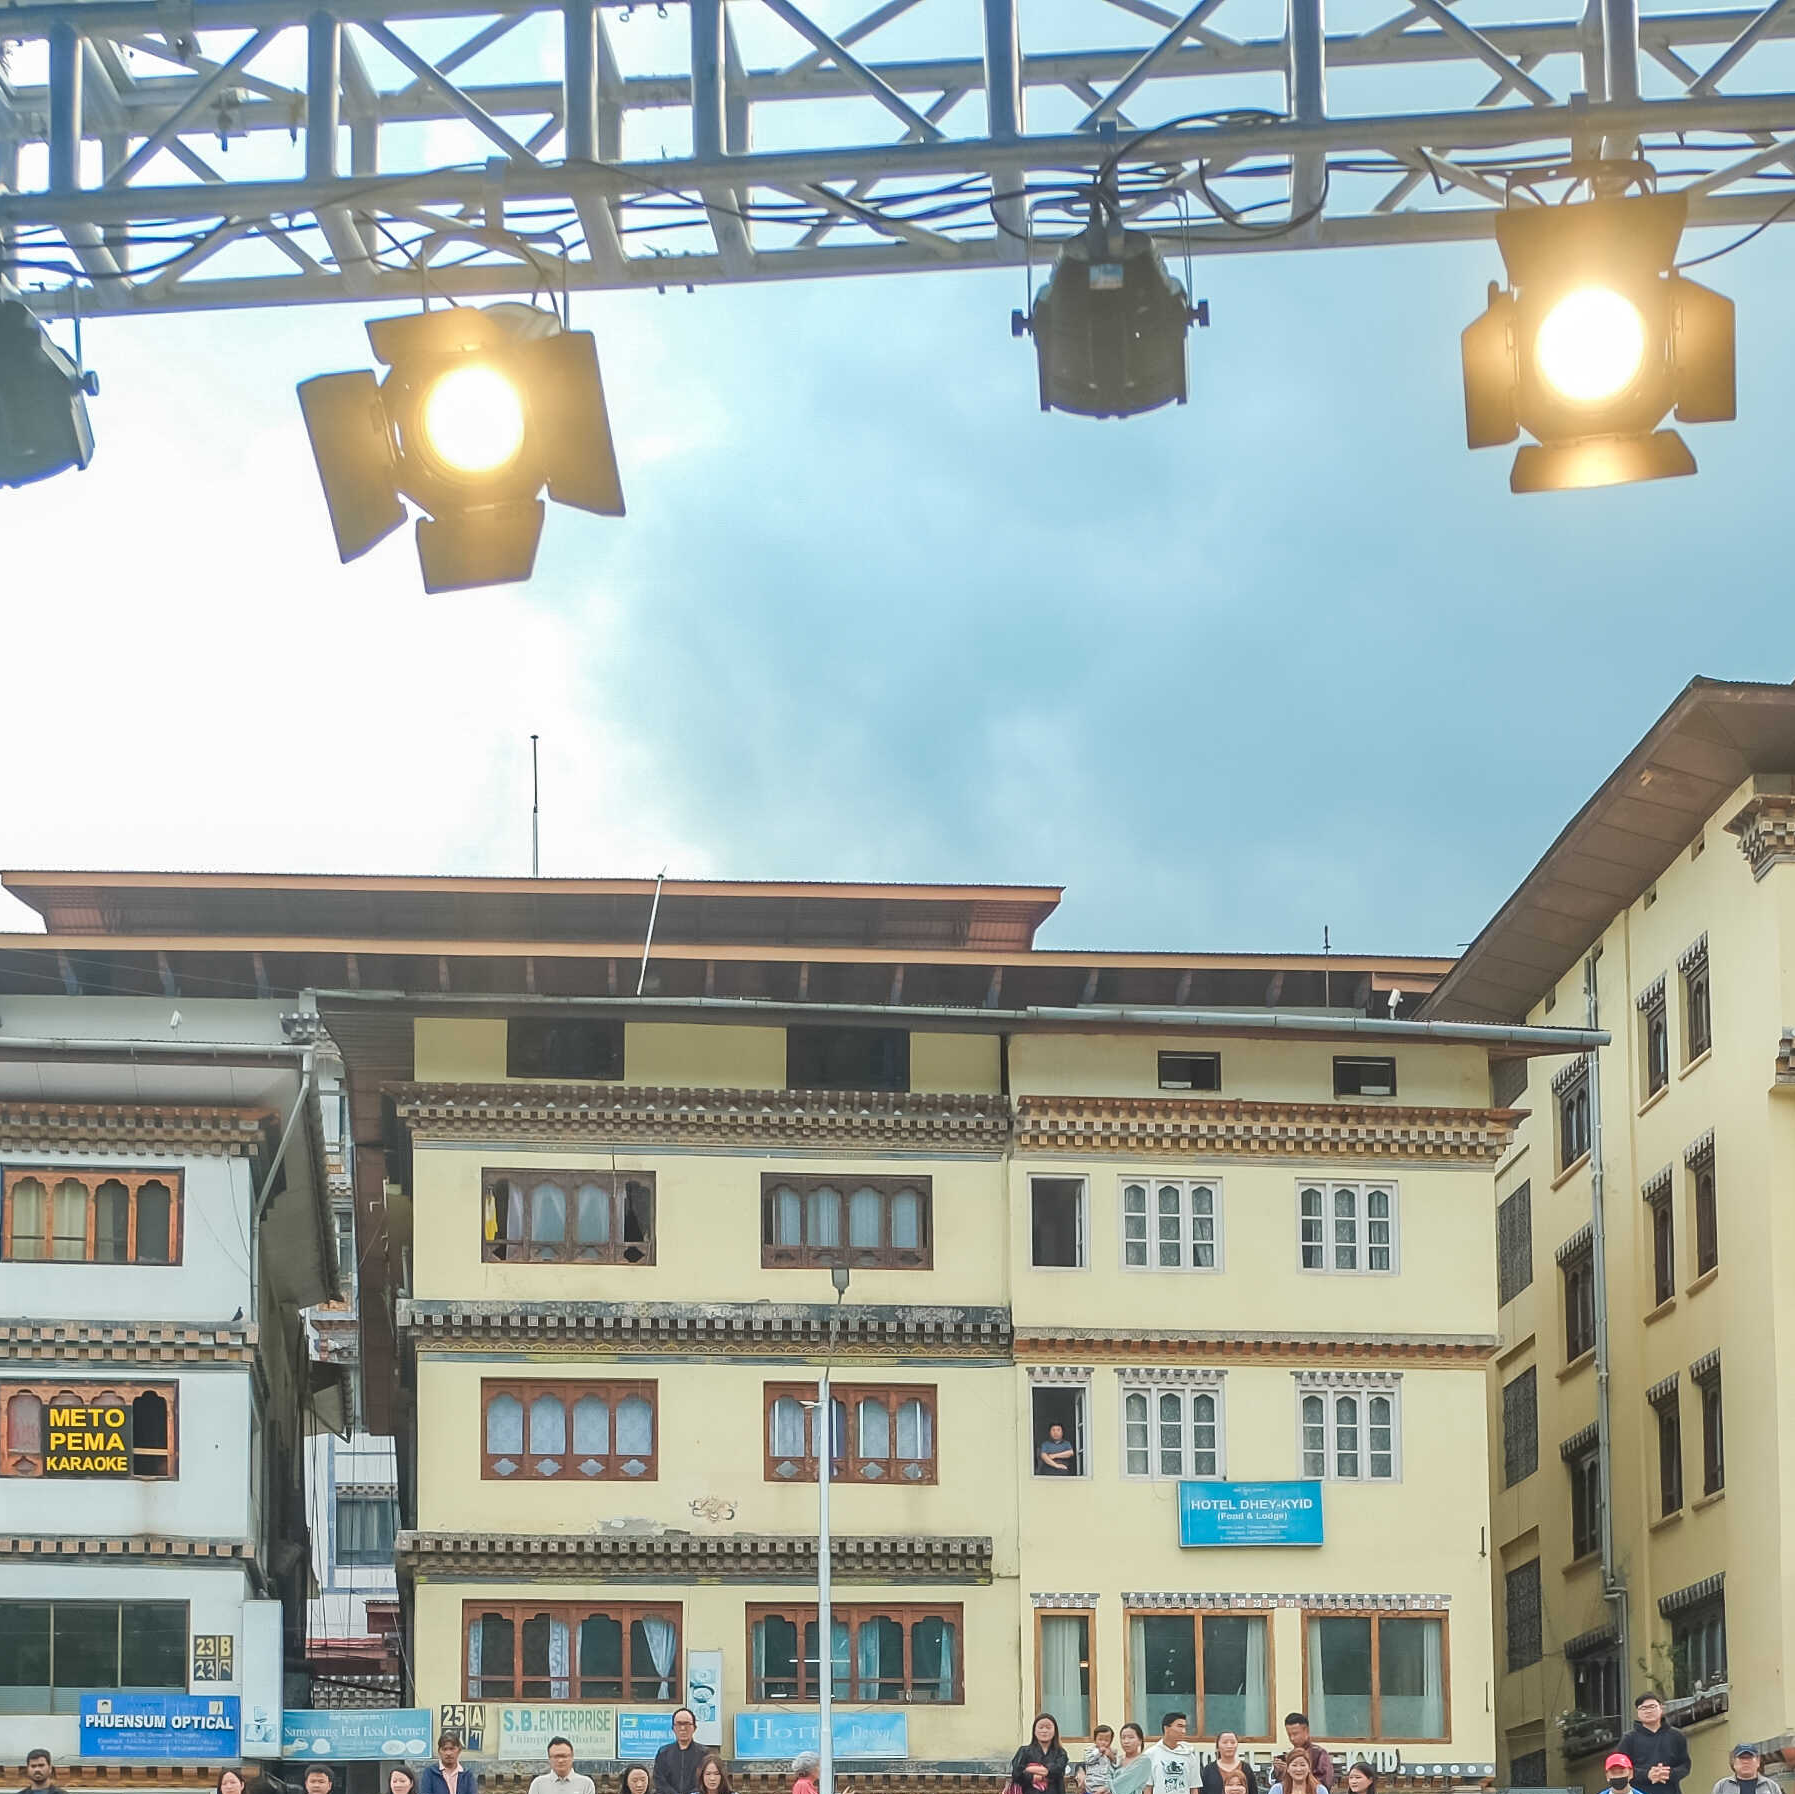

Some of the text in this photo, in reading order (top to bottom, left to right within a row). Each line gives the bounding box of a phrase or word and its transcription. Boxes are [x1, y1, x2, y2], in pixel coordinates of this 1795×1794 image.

[49, 1408, 125, 1428] METO
[50, 1432, 125, 1451] PEMA
[46, 1456, 128, 1471] KARAOKE
[1191, 1498, 1313, 1510] HOTEL DHEY-KYID
[85, 1714, 234, 1730] PHUENSUM OPTICAL
[363, 1725, 387, 1737] Food
